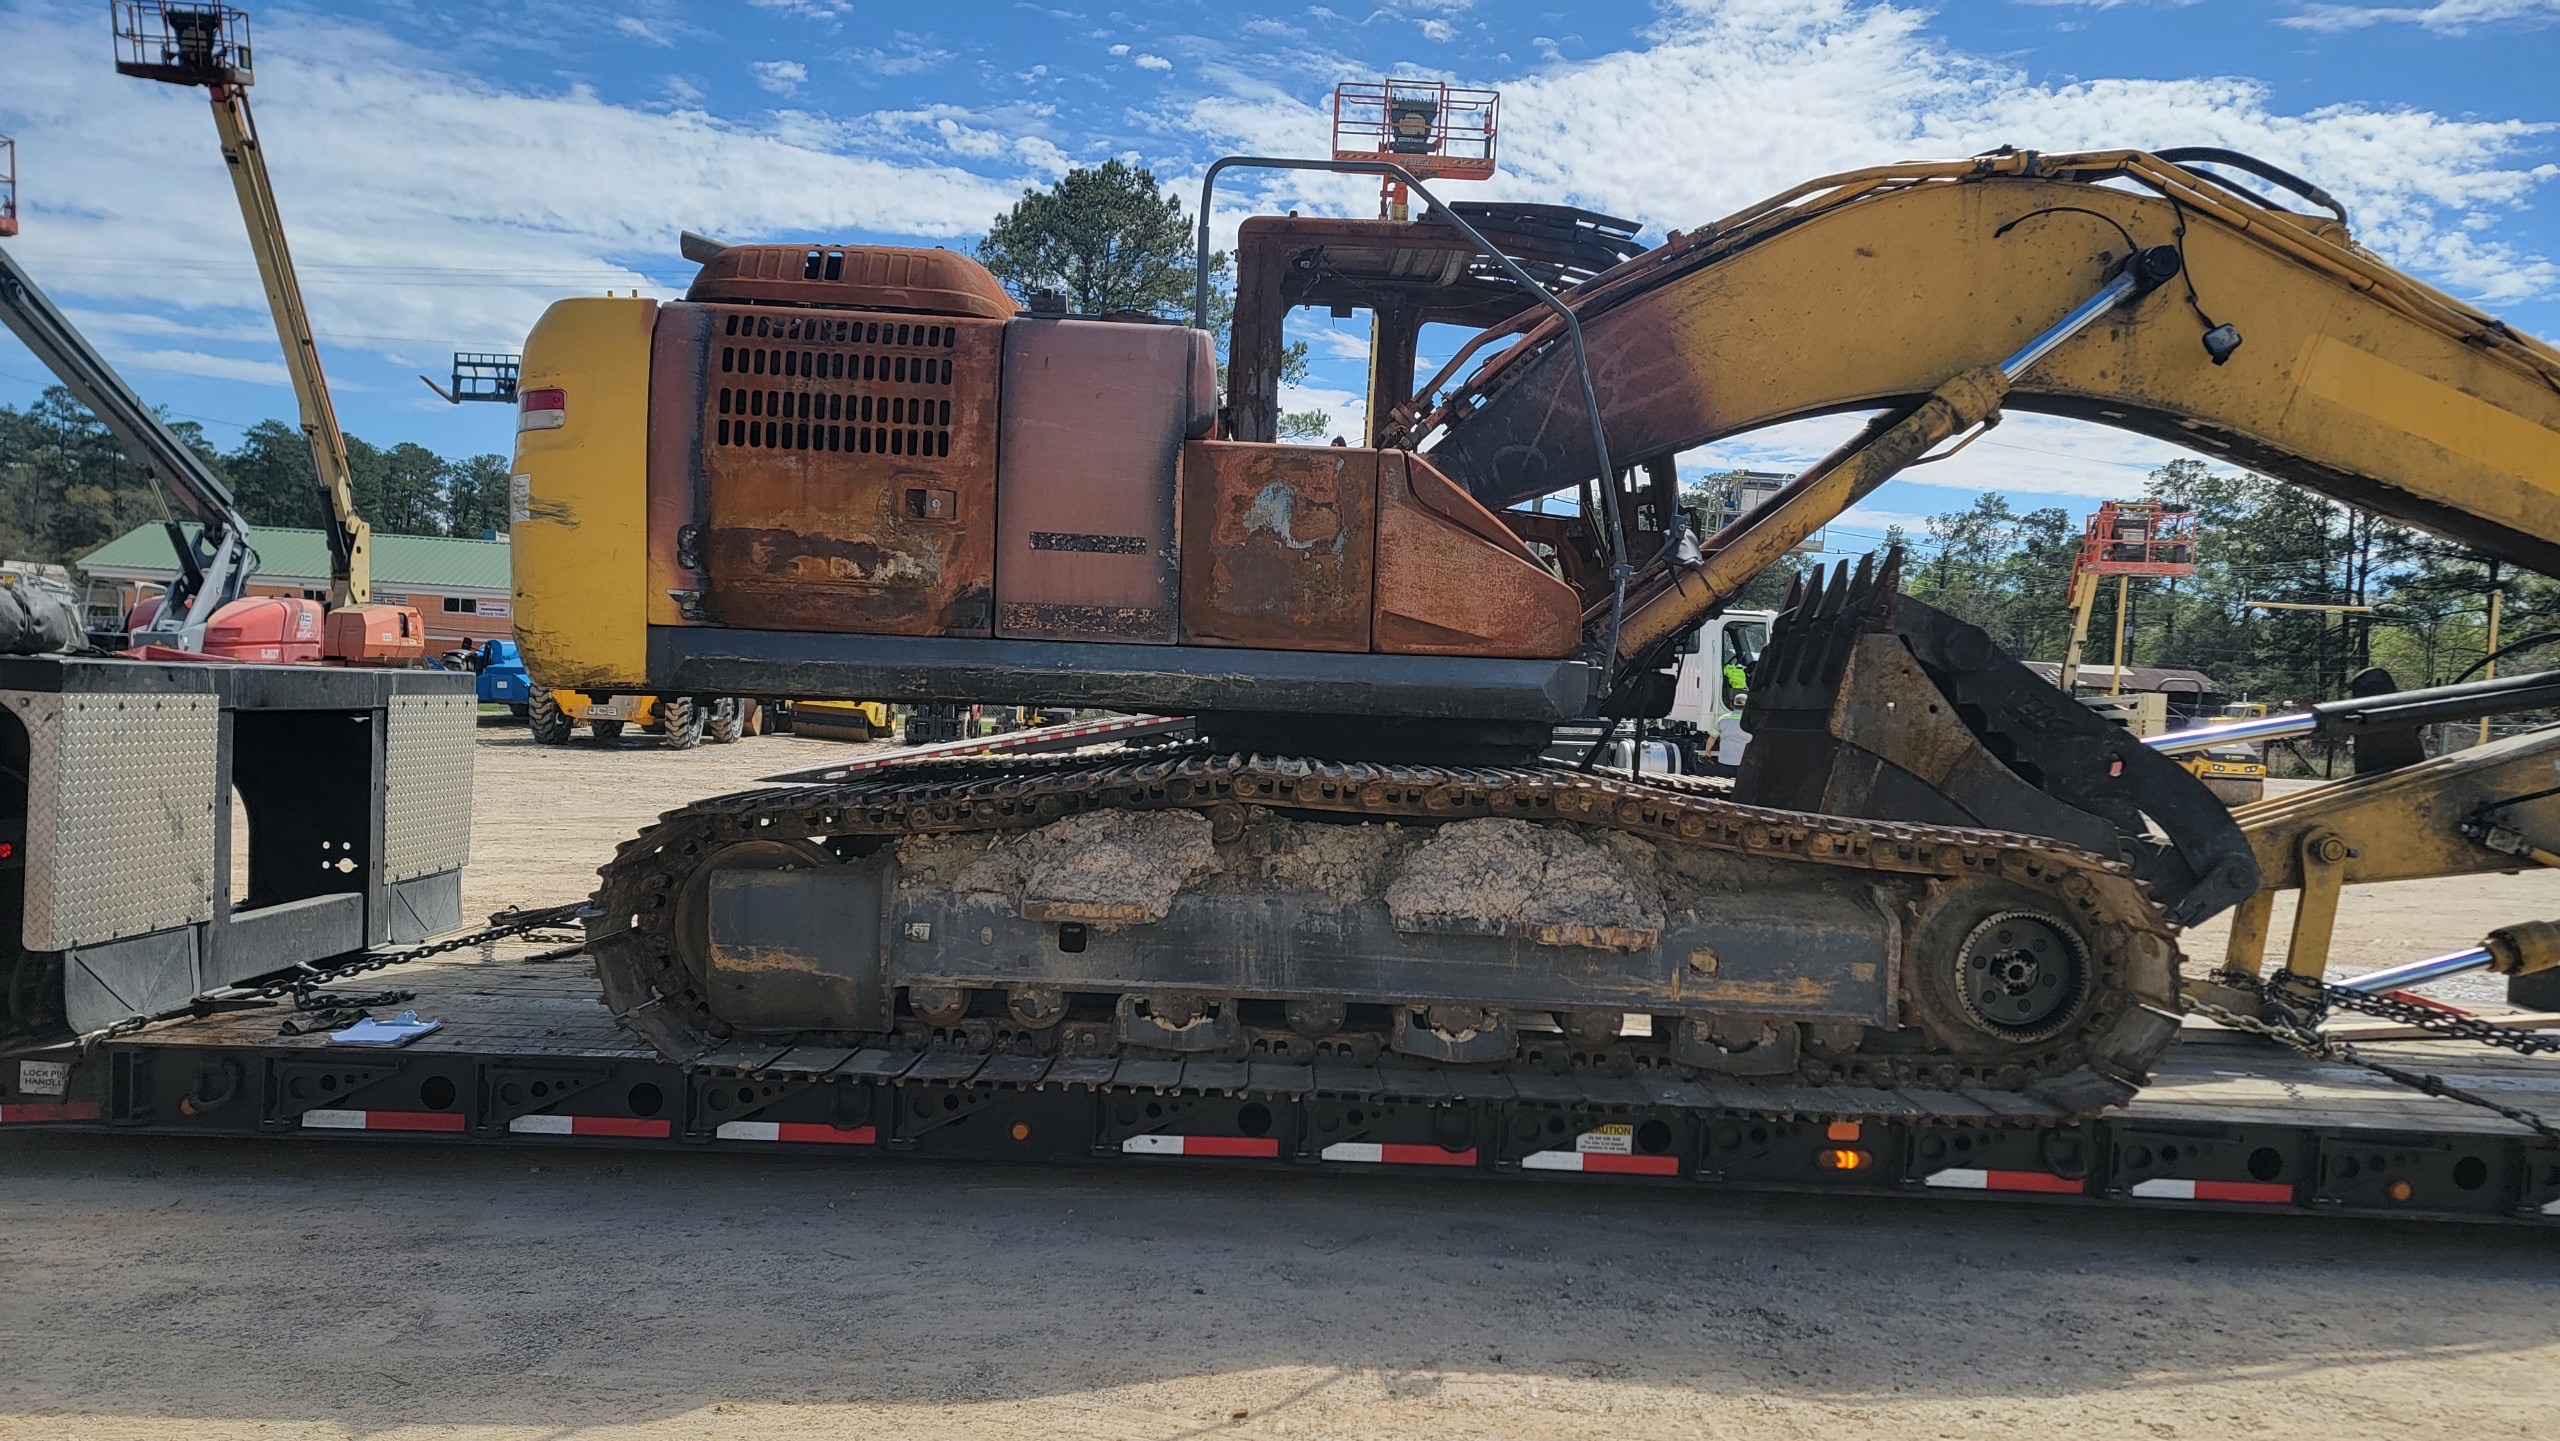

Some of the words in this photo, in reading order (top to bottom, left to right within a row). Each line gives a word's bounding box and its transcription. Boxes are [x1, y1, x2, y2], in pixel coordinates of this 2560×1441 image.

[588, 706, 617, 716] JCB
[23, 1069, 49, 1077] LOCK
[51, 1070, 66, 1079] PIN
